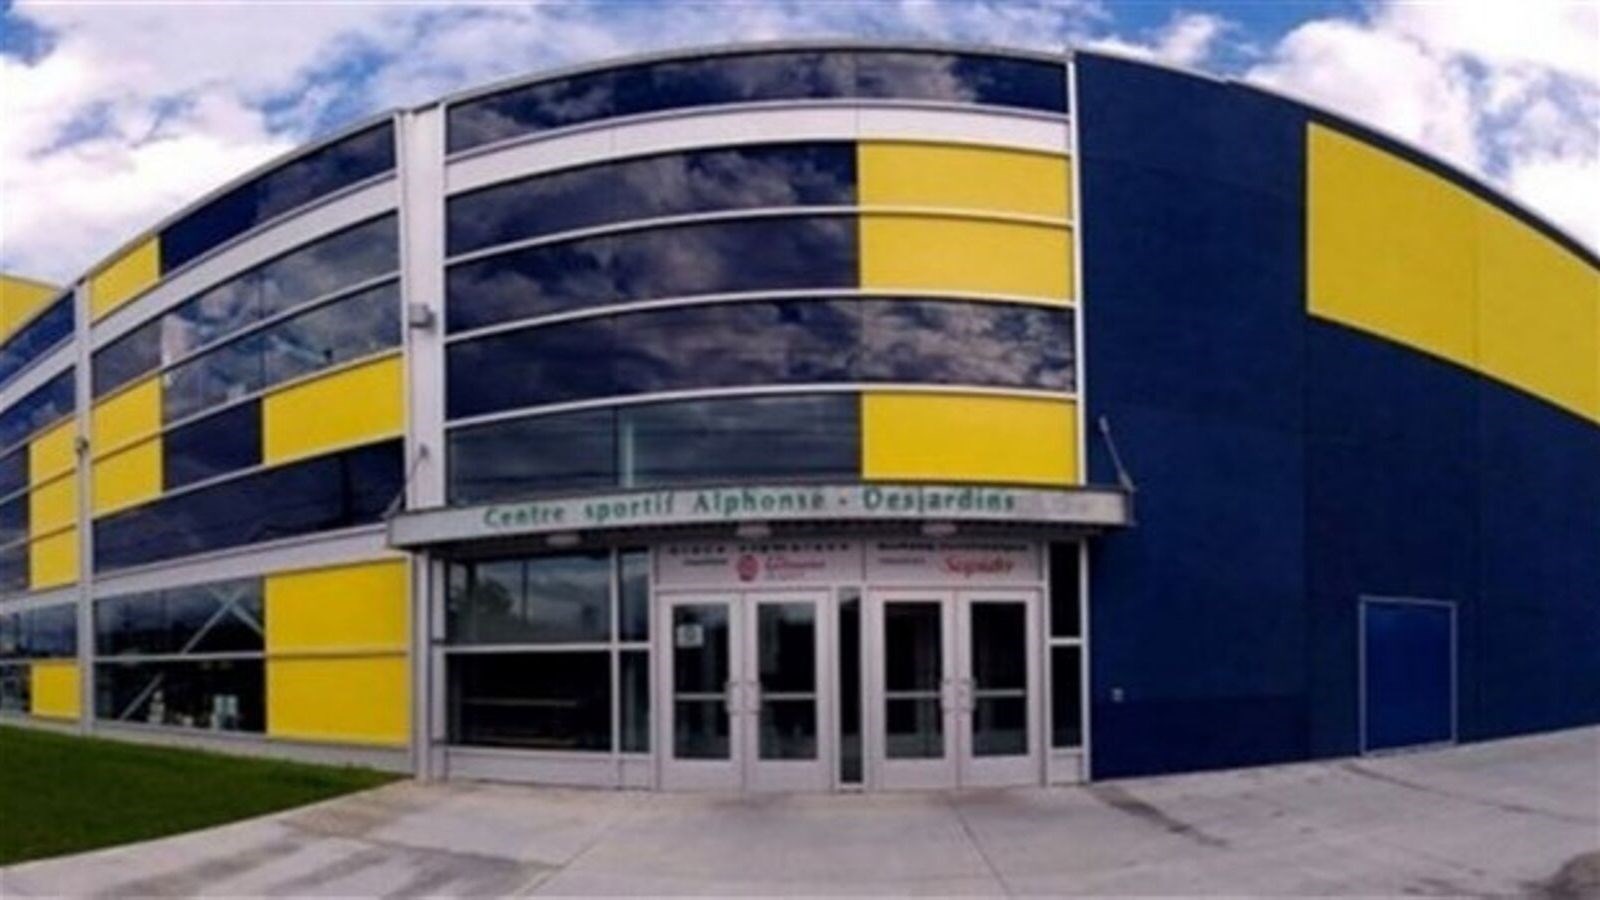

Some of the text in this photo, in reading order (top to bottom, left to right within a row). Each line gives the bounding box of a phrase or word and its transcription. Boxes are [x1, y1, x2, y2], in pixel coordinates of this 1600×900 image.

[484, 505, 564, 526] Centre
[584, 493, 673, 521] sportif
[693, 487, 823, 515] Alphonse
[863, 487, 1014, 513] Desjardins
